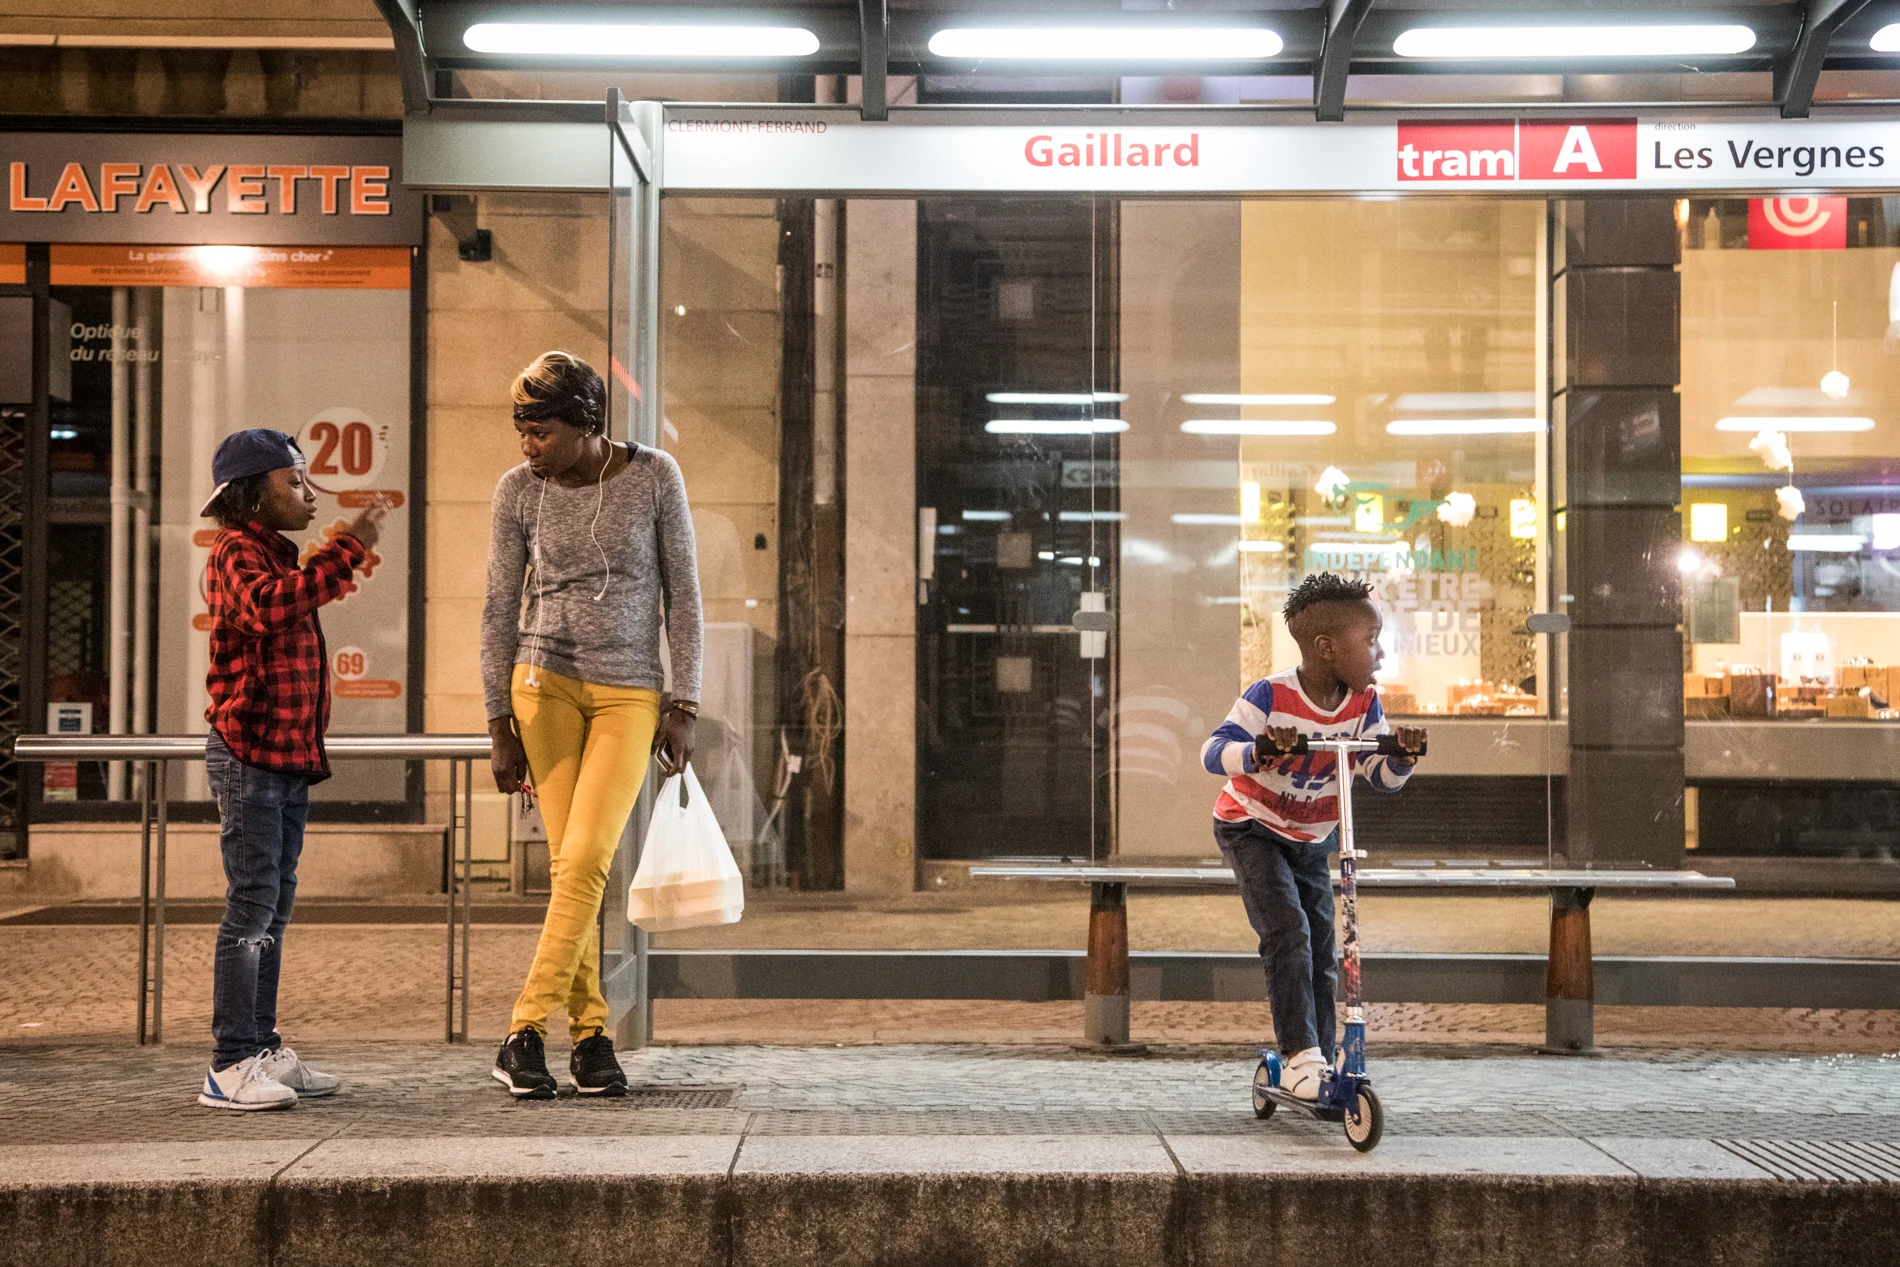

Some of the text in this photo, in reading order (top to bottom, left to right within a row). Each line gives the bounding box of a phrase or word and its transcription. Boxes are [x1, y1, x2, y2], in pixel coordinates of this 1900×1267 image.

[668, 120, 827, 134] CLERMONT-FERRAND
[1655, 122, 1696, 131] direction
[1024, 133, 1200, 168] Gaillard
[1399, 126, 1604, 178] tram A
[1654, 140, 1885, 177] Les Vergnes
[9, 162, 391, 215] LAFAYETTE
[128, 250, 145, 261] La
[290, 249, 321, 262] cher
[70, 346, 93, 362] du
[308, 421, 373, 476] 20
[1394, 633, 1478, 657] MIEUX
[337, 652, 364, 675] 69
